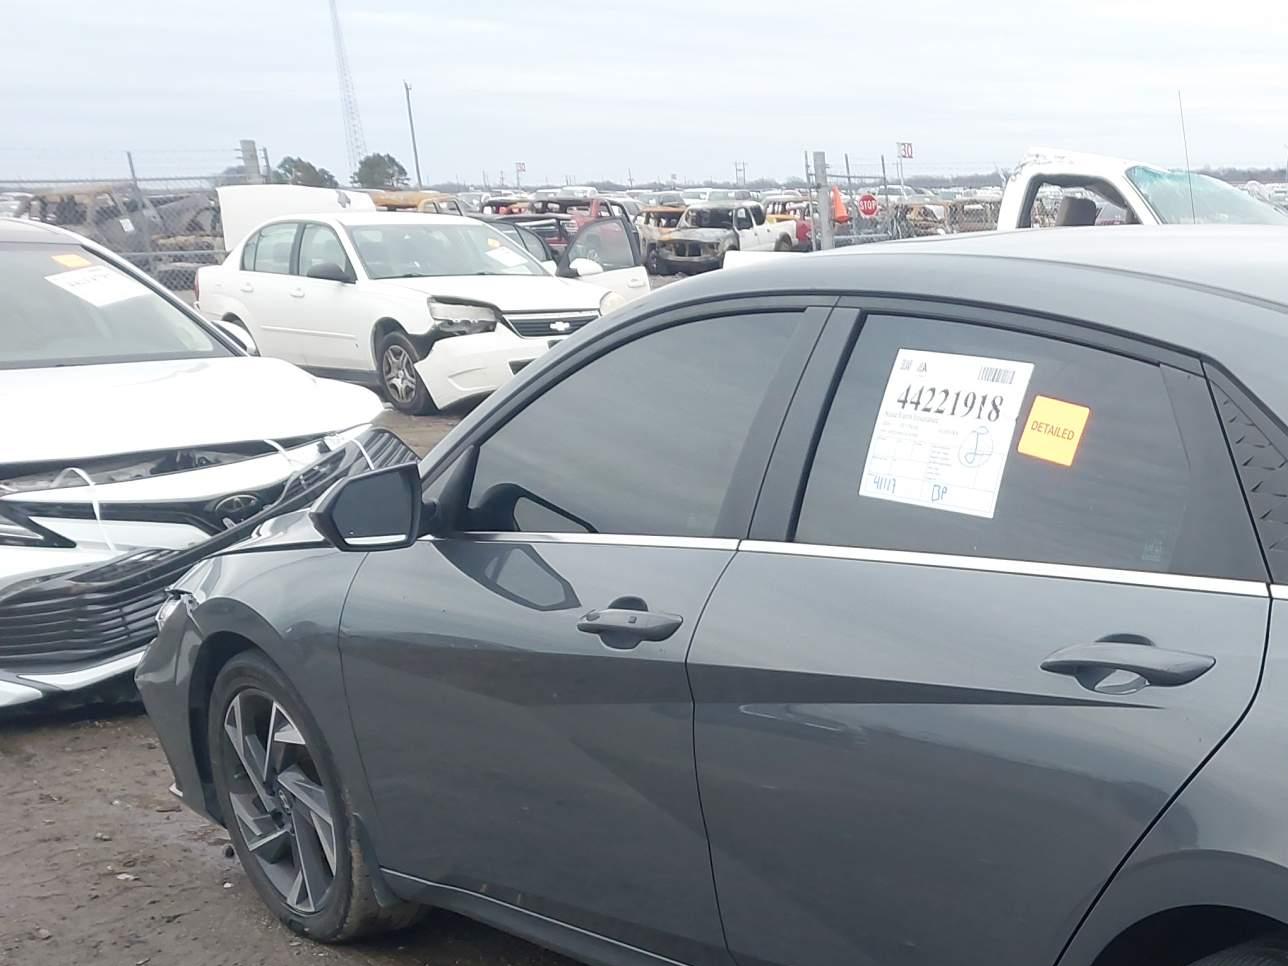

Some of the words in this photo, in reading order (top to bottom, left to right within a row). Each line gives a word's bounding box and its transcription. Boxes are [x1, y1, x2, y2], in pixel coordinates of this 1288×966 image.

[860, 199, 875, 210] STOP
[897, 384, 1004, 422] 44221918
[1031, 420, 1075, 440] DETAILED
